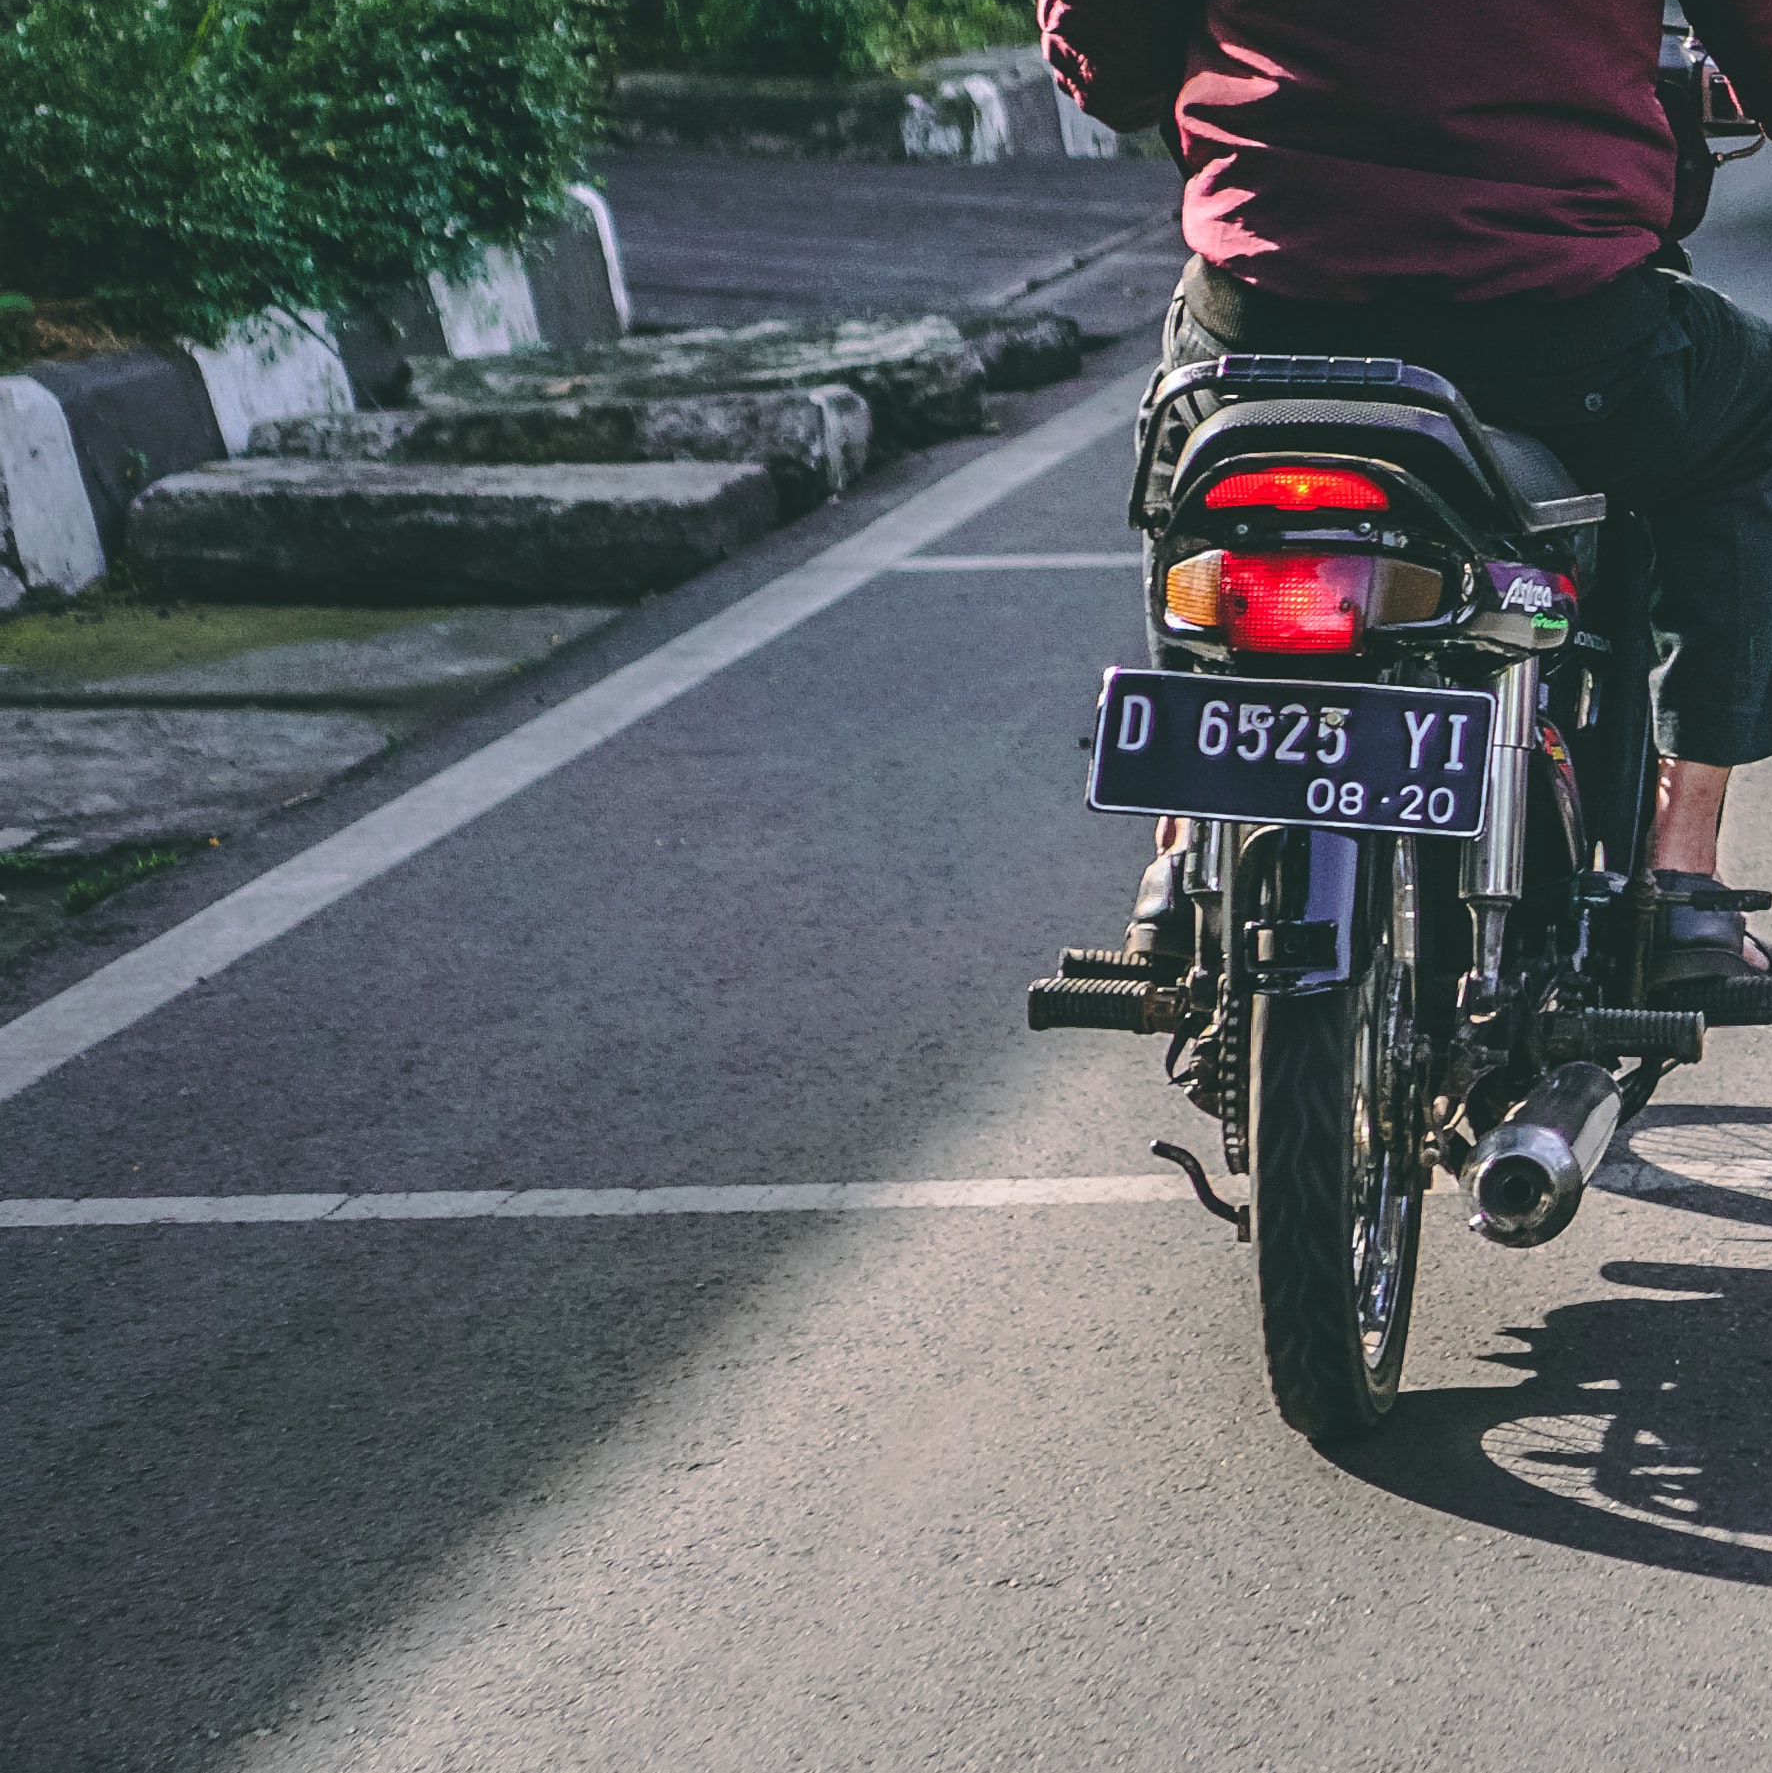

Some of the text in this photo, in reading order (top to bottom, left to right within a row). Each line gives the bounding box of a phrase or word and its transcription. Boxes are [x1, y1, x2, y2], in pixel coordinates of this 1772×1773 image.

[1116, 695, 1469, 772] D 6525 YI
